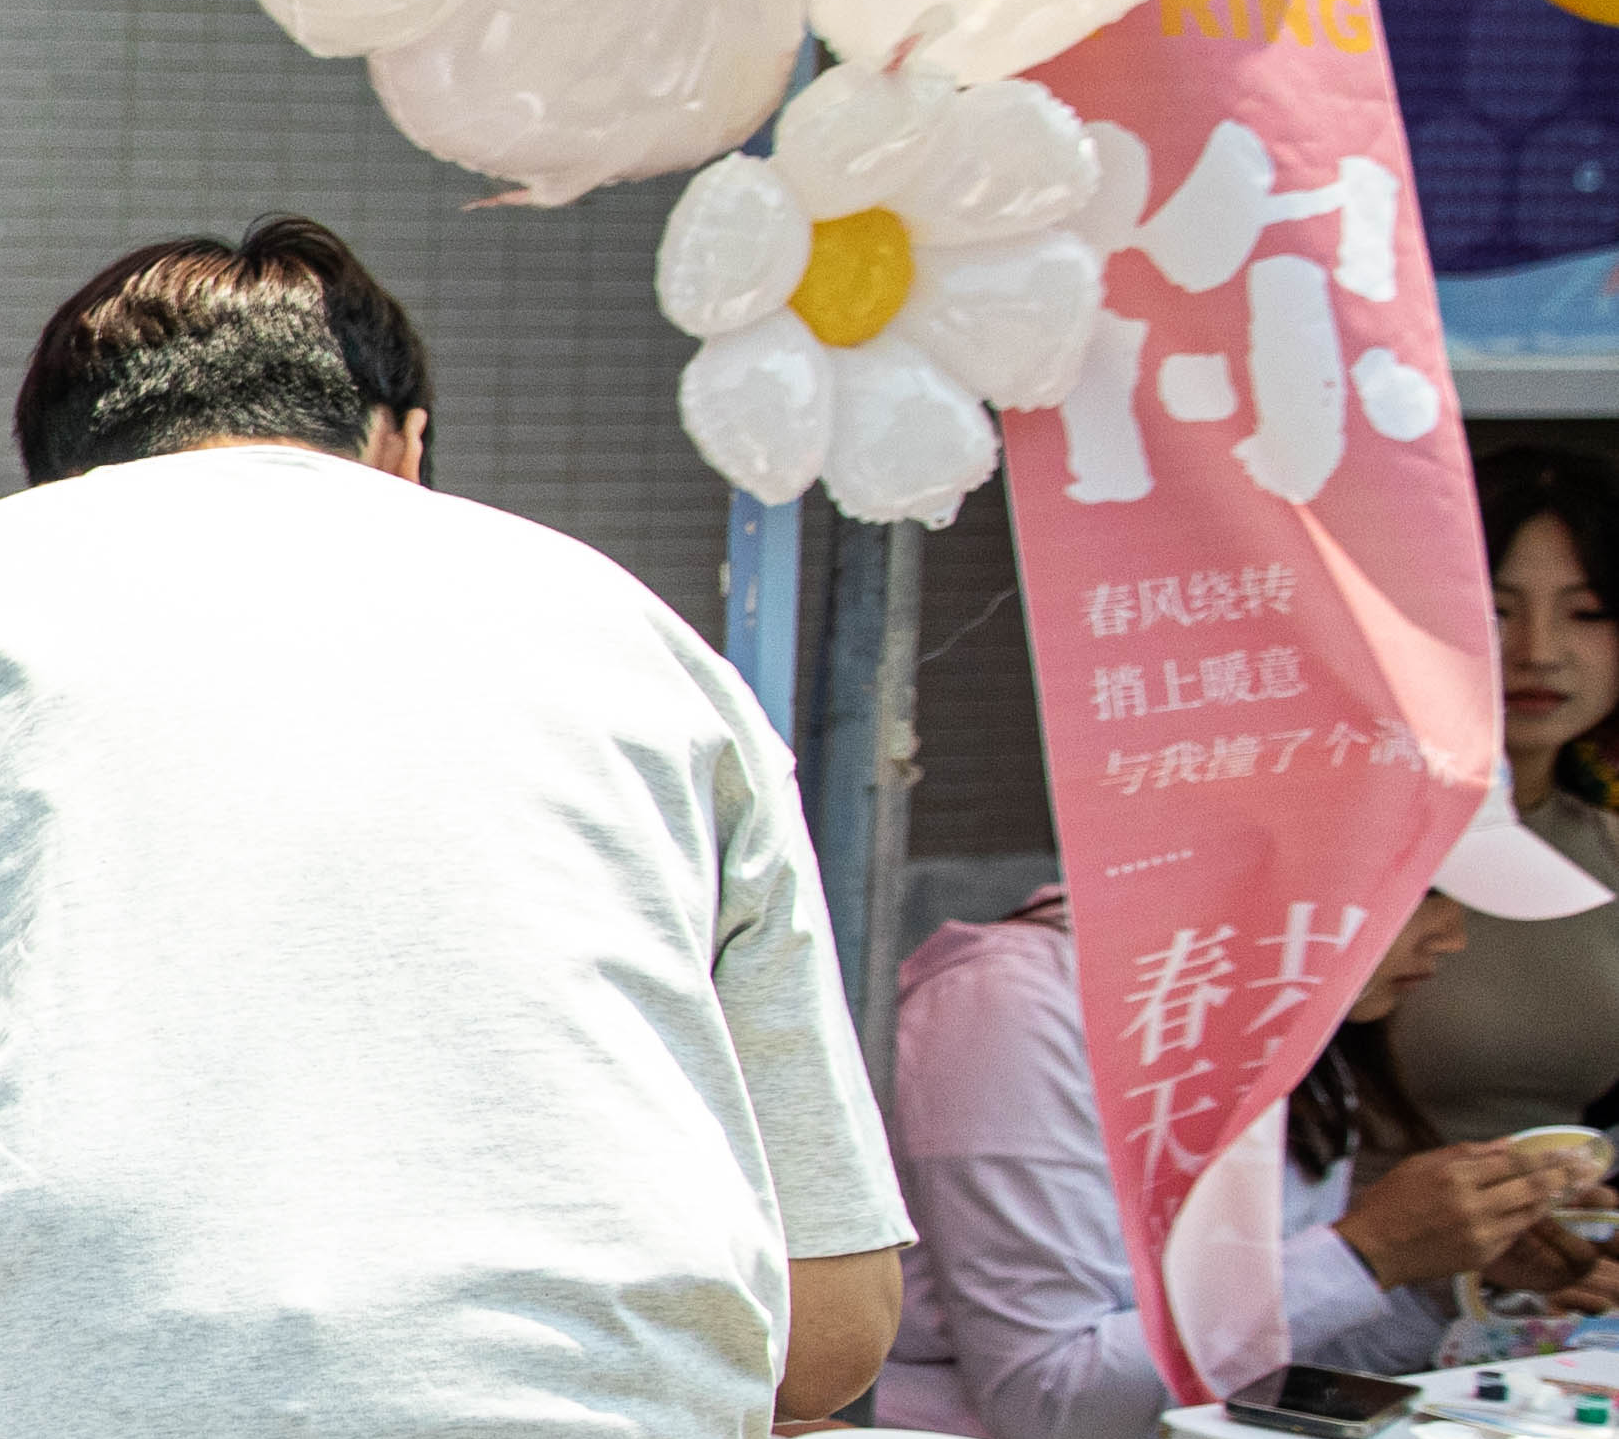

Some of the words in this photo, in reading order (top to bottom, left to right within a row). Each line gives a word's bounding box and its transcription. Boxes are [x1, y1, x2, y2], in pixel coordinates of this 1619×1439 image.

[1080, 562, 1297, 638] 春风绕转
[1089, 645, 1309, 721] 捎上暖意
